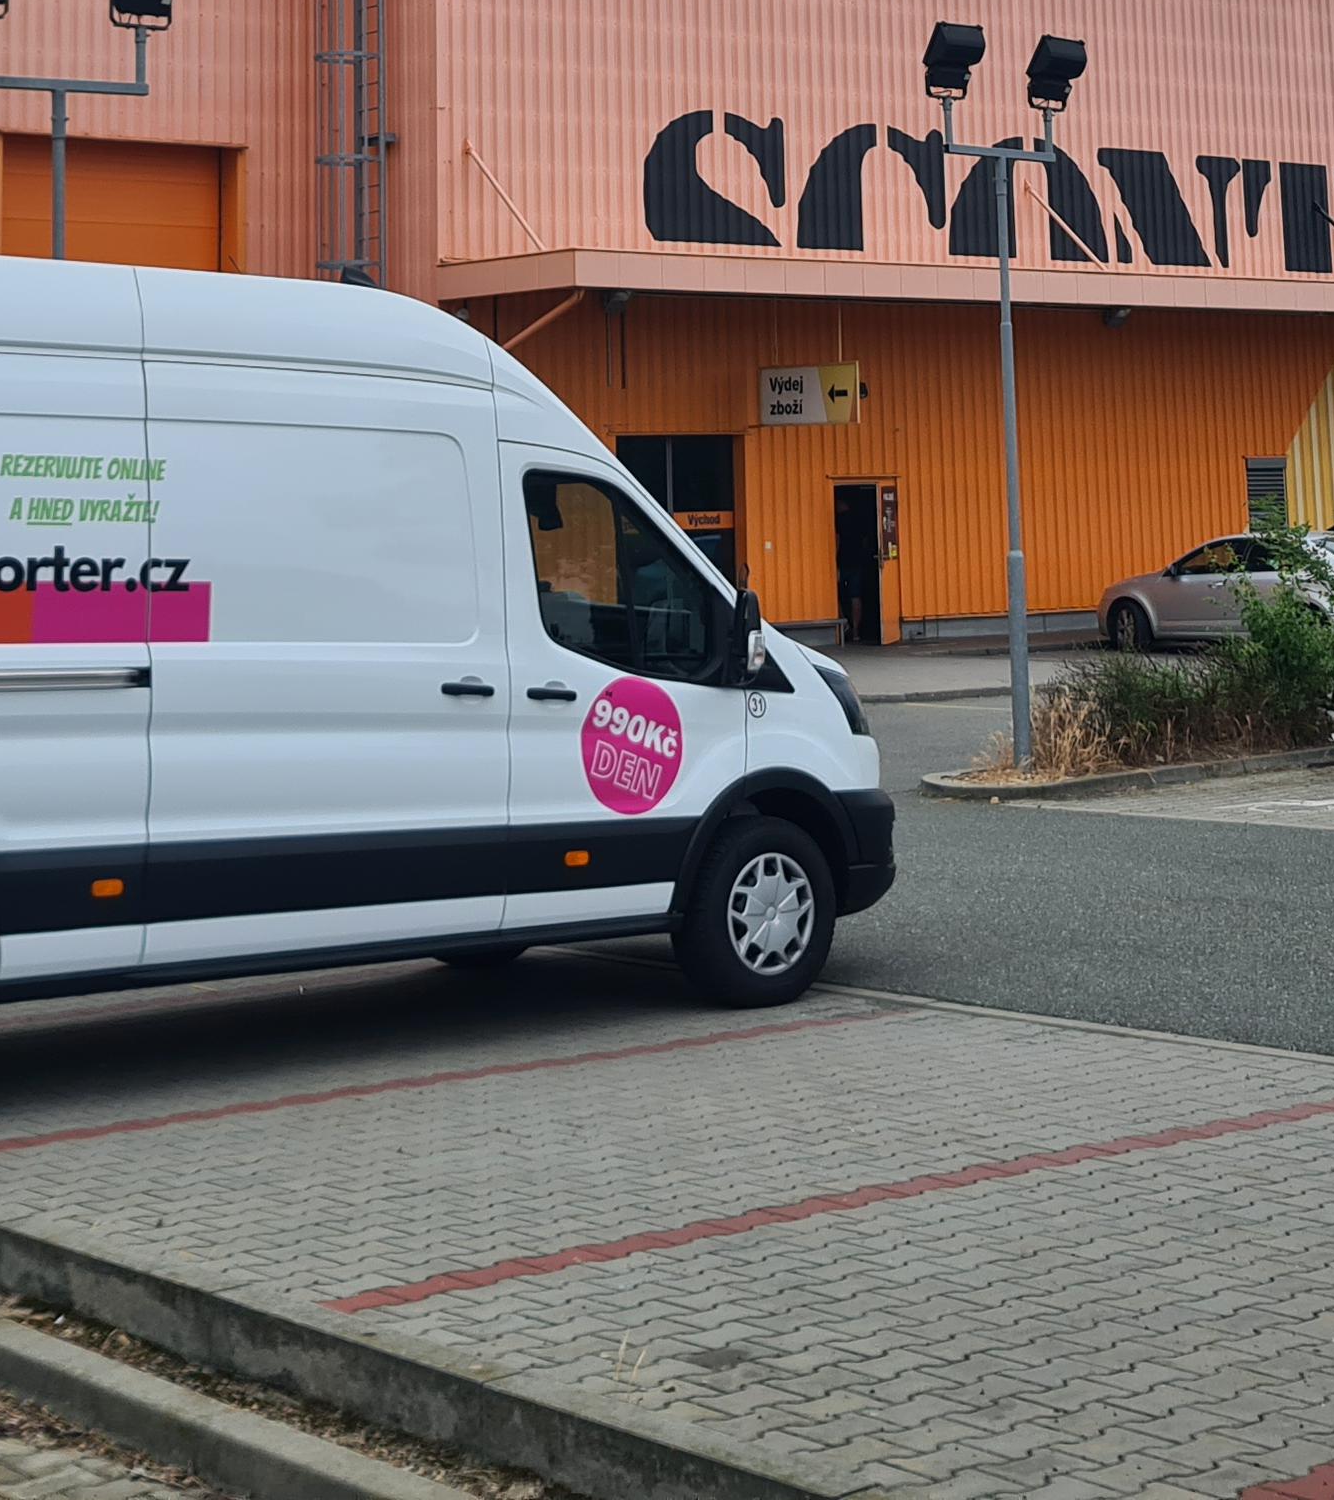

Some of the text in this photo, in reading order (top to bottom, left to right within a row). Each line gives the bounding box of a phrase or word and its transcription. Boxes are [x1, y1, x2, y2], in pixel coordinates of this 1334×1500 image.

[769, 376, 803, 395] Výdej
[770, 399, 803, 415] zboží
[0, 454, 166, 481] REZERVUJTE ONLINE
[9, 493, 160, 523] A HNED VYRAŽTE!
[687, 513, 721, 527] Východ
[752, 697, 763, 712] 31
[592, 698, 678, 758] 990Kč
[591, 739, 663, 801] DEN
